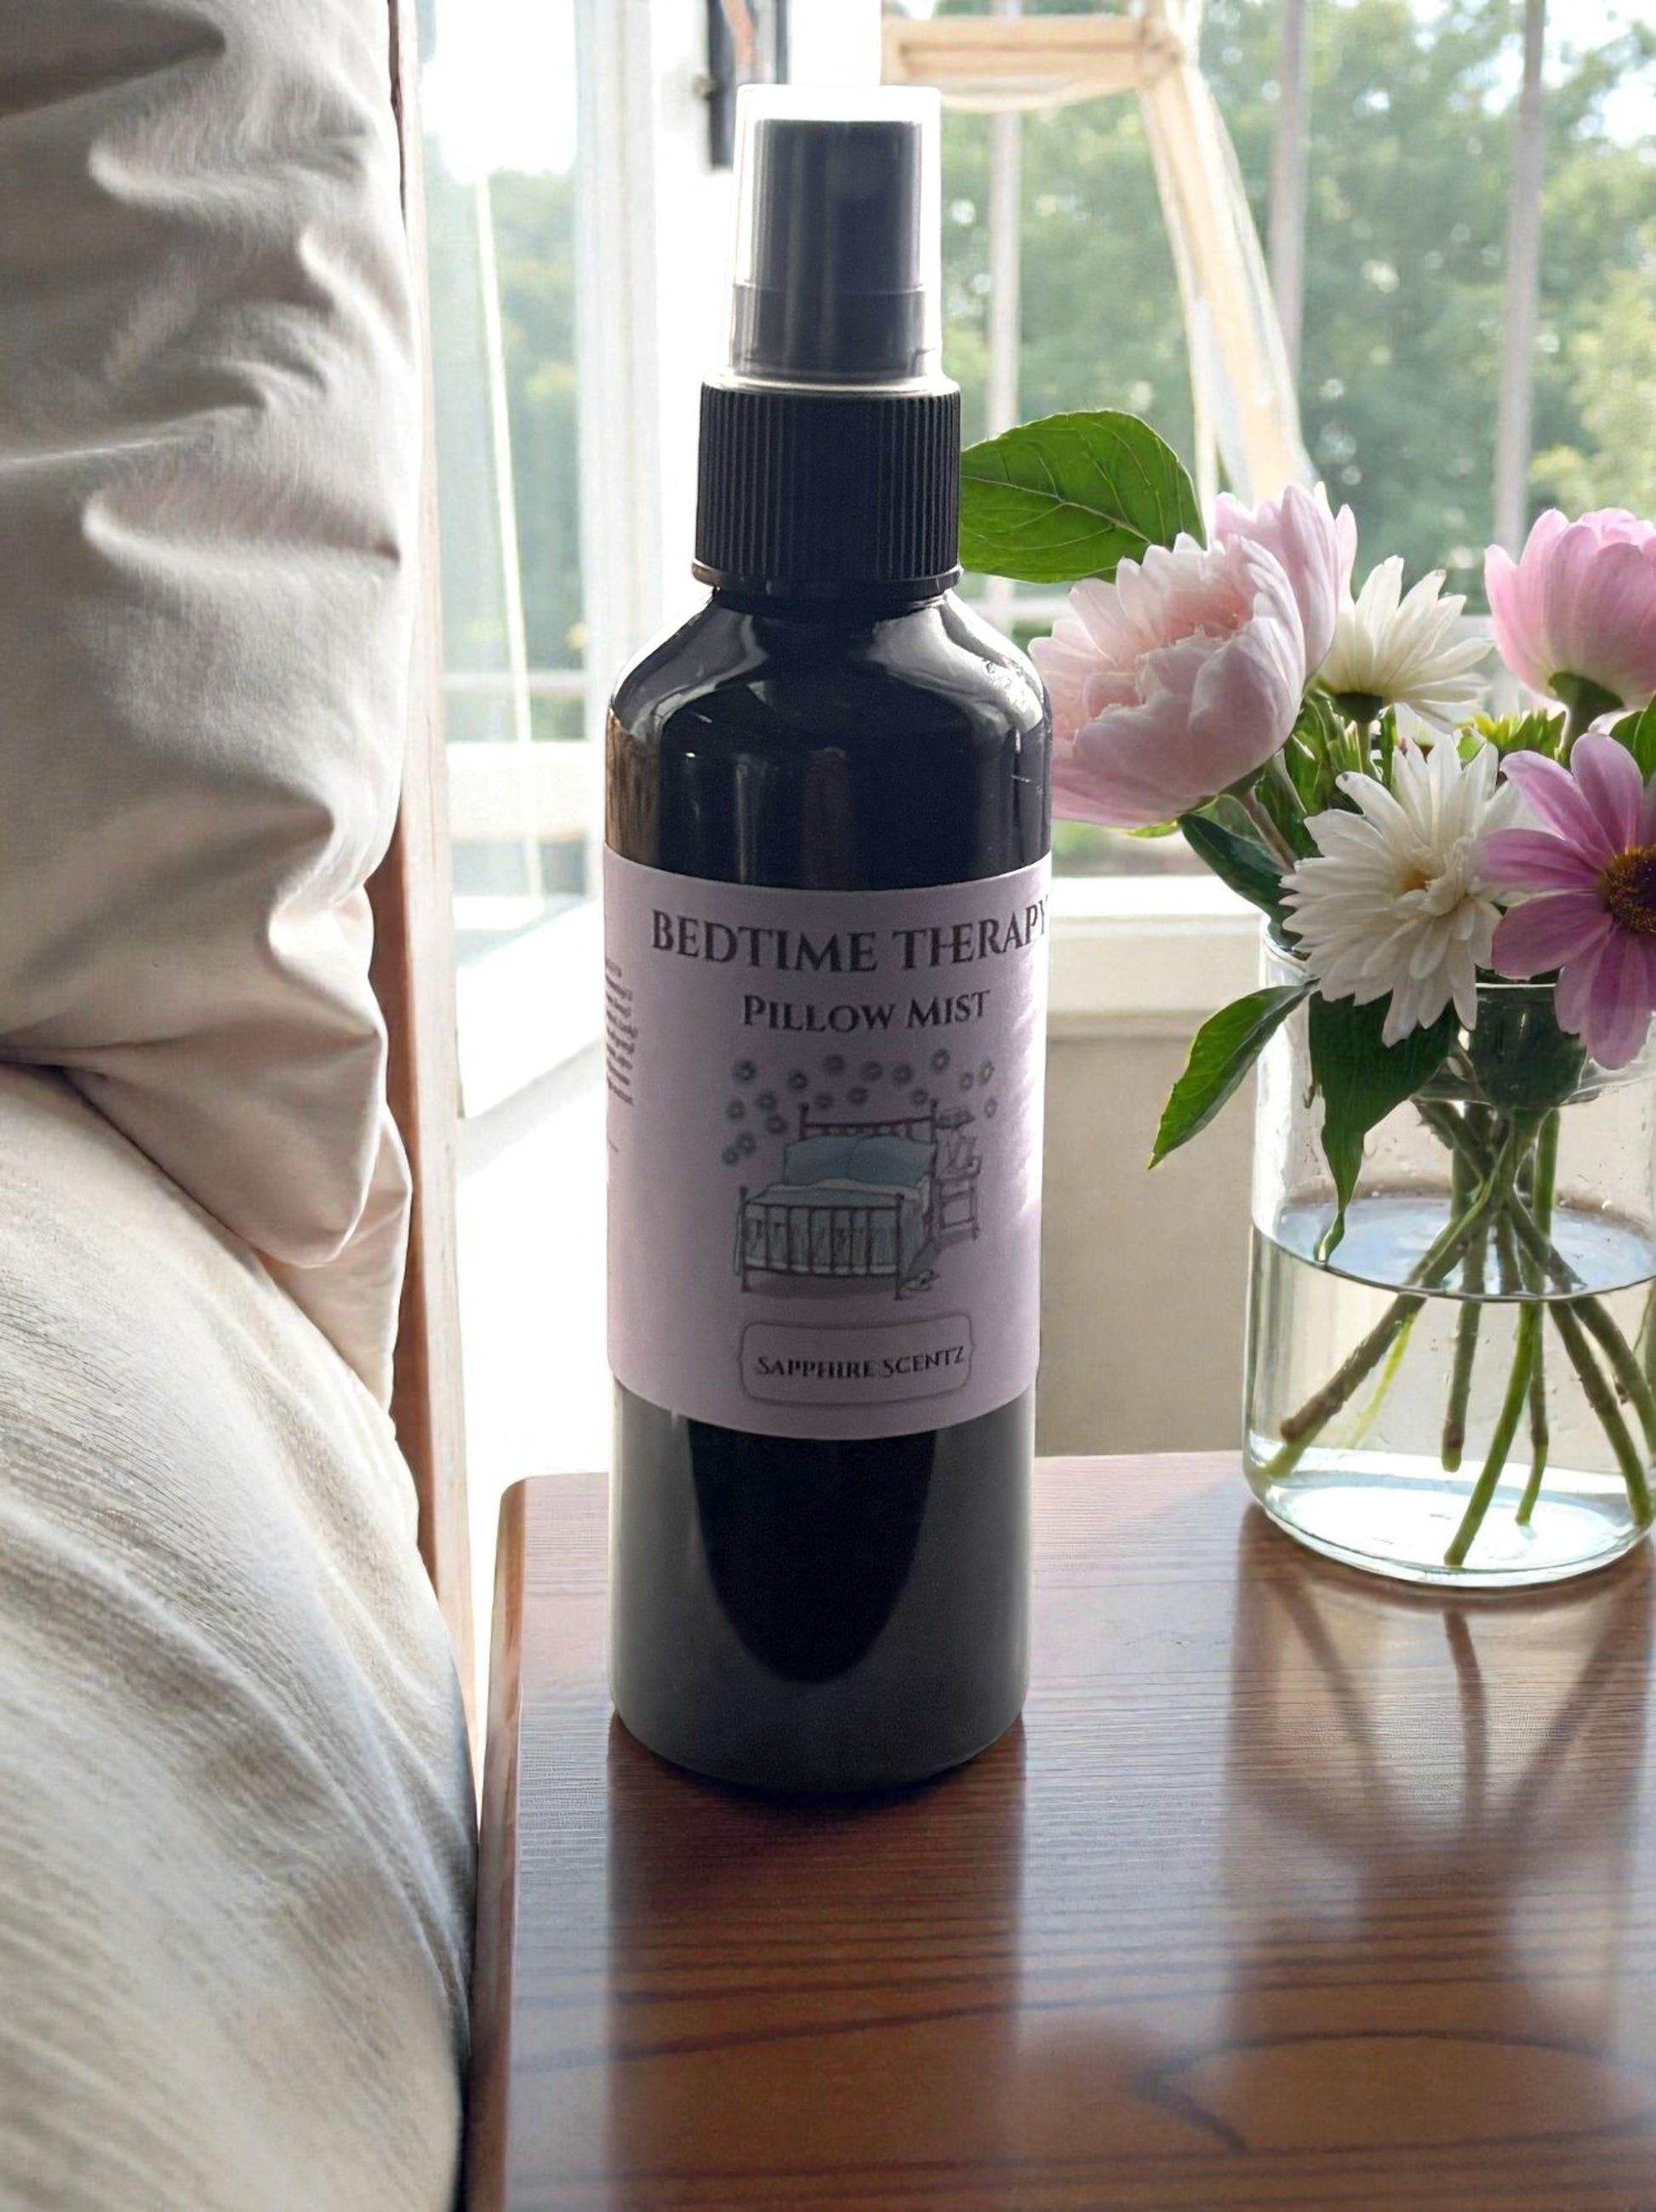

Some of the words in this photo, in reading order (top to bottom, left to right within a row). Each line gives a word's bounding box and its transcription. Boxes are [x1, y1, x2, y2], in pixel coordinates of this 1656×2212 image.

[652, 909, 878, 972] BEDTIME
[893, 894, 1048, 970] THERAPY
[743, 994, 895, 1032] PILLOW
[906, 989, 991, 1029] MIST
[757, 1356, 877, 1380] SAPPHIRE
[882, 1346, 964, 1378] SCENTZ
